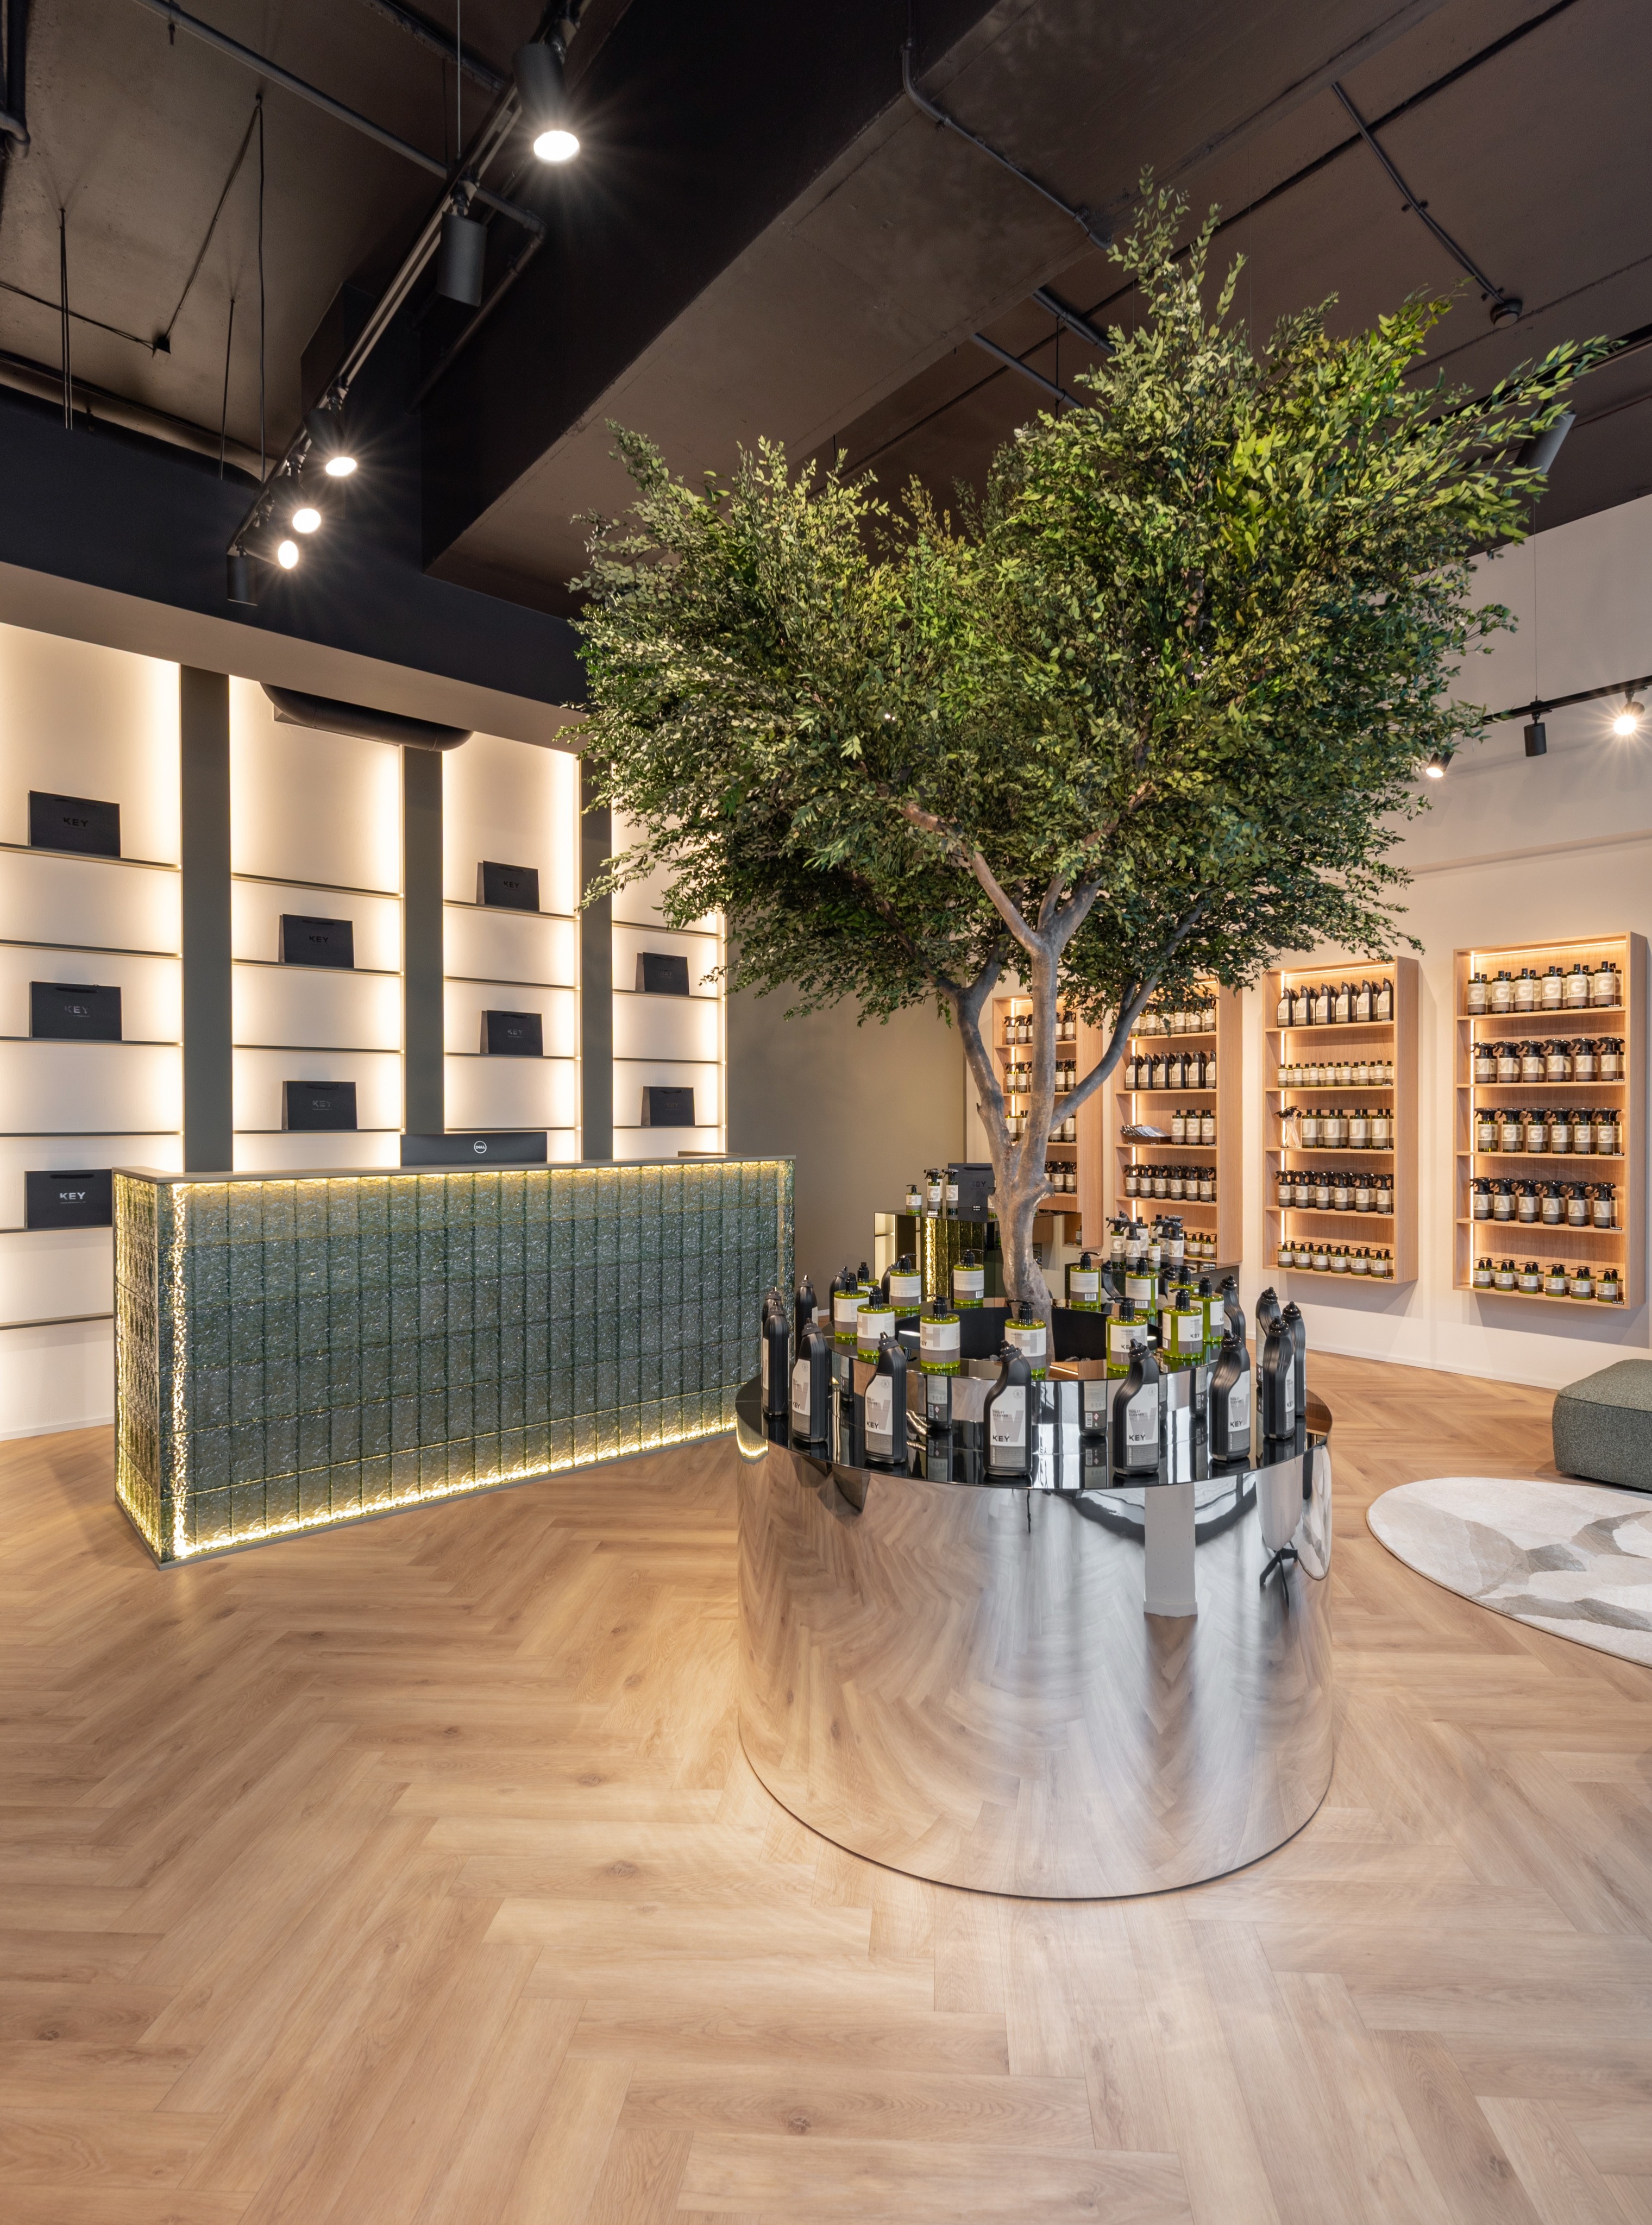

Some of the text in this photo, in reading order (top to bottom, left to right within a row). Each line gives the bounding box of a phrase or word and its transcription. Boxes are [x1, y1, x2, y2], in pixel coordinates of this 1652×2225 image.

[64, 818, 88, 827] KEY
[1516, 983, 1531, 999] G
[1543, 980, 1559, 996] G
[1568, 978, 1585, 995] G
[1596, 976, 1613, 994] G
[1468, 986, 1484, 1002] G
[1493, 984, 1509, 1000] G
[928, 1188, 939, 1200] G
[948, 1187, 956, 1199] S
[1474, 1197, 1485, 1208] A
[1496, 1197, 1507, 1209] A
[1519, 1198, 1530, 1211] A
[1546, 1200, 1557, 1212] A
[1571, 1202, 1582, 1215] A
[1594, 1203, 1605, 1216] A
[866, 1421, 879, 1429] KEY
